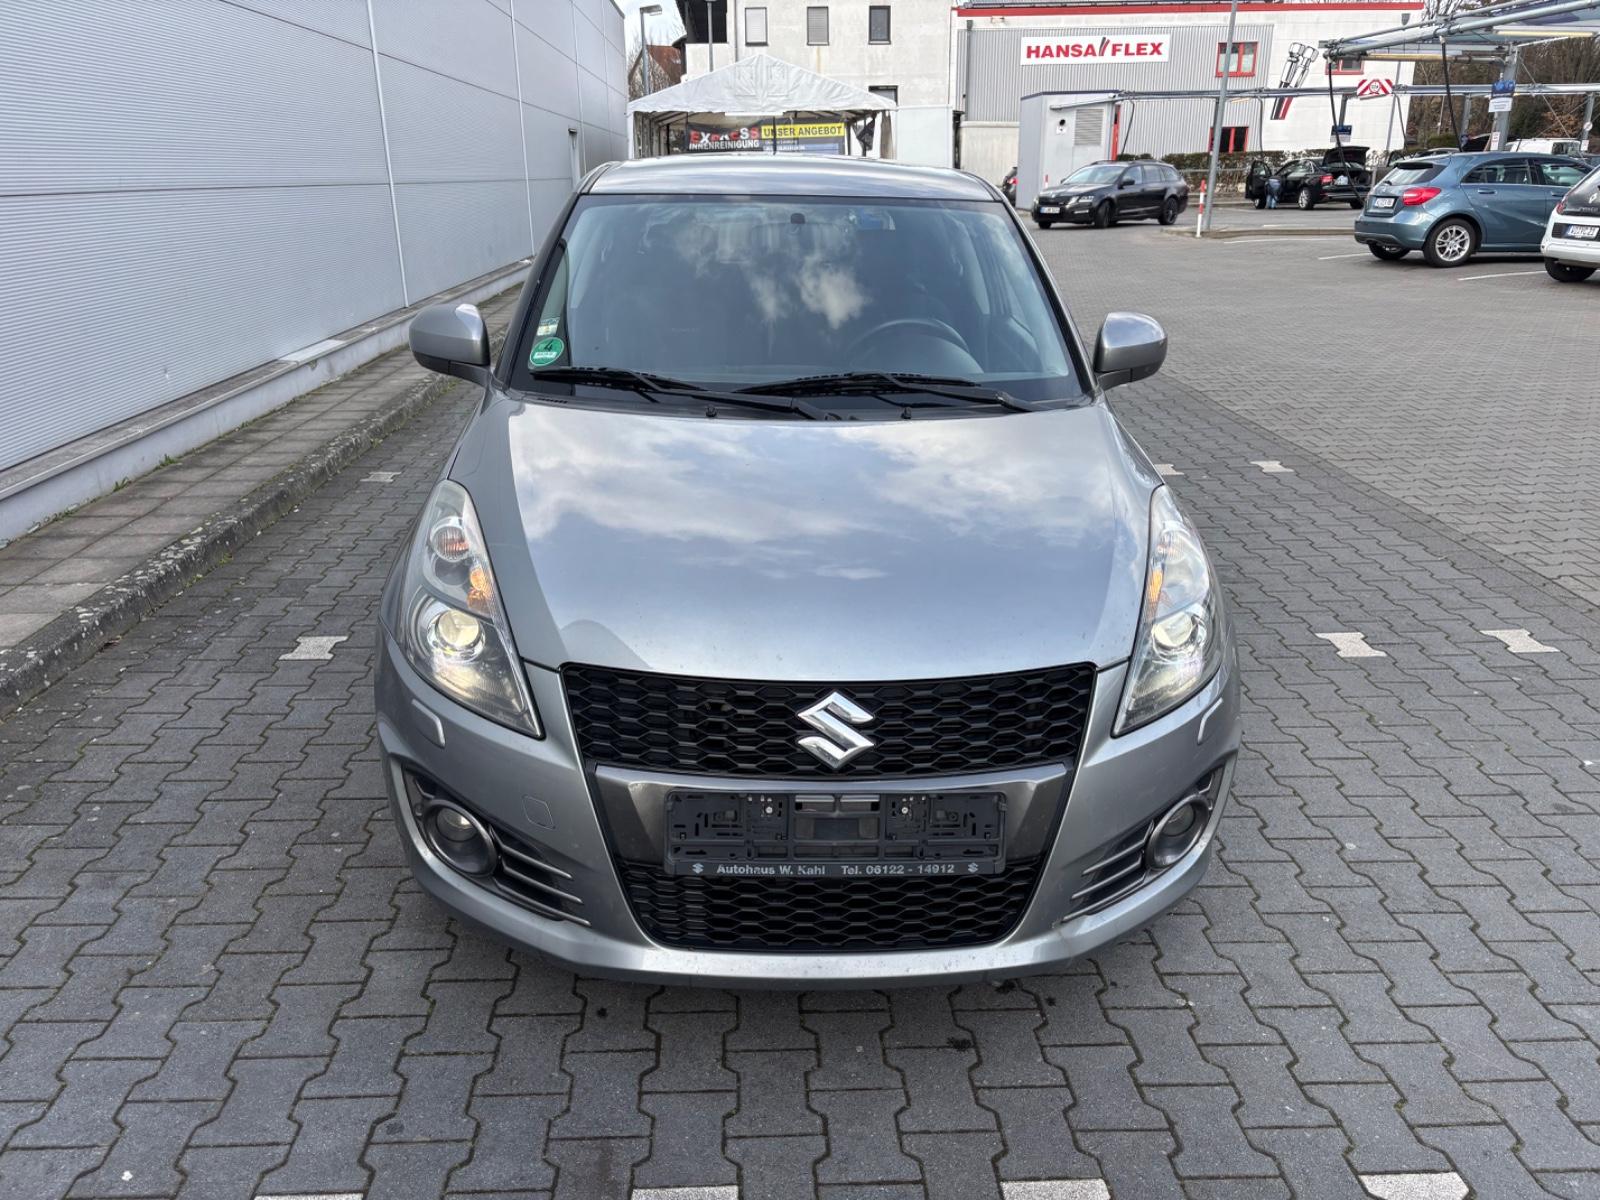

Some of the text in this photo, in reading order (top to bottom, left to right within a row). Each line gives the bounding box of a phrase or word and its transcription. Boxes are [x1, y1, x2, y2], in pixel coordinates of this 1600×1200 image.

[1026, 42, 1164, 59] HANSA FLEX
[798, 125, 842, 136] ANGEBOT
[716, 864, 775, 875] Autohaus
[779, 865, 794, 875] W.
[797, 865, 826, 875] Kahl
[841, 865, 862, 875] Tel.
[865, 864, 905, 875] 06122
[917, 863, 955, 875] 14912
